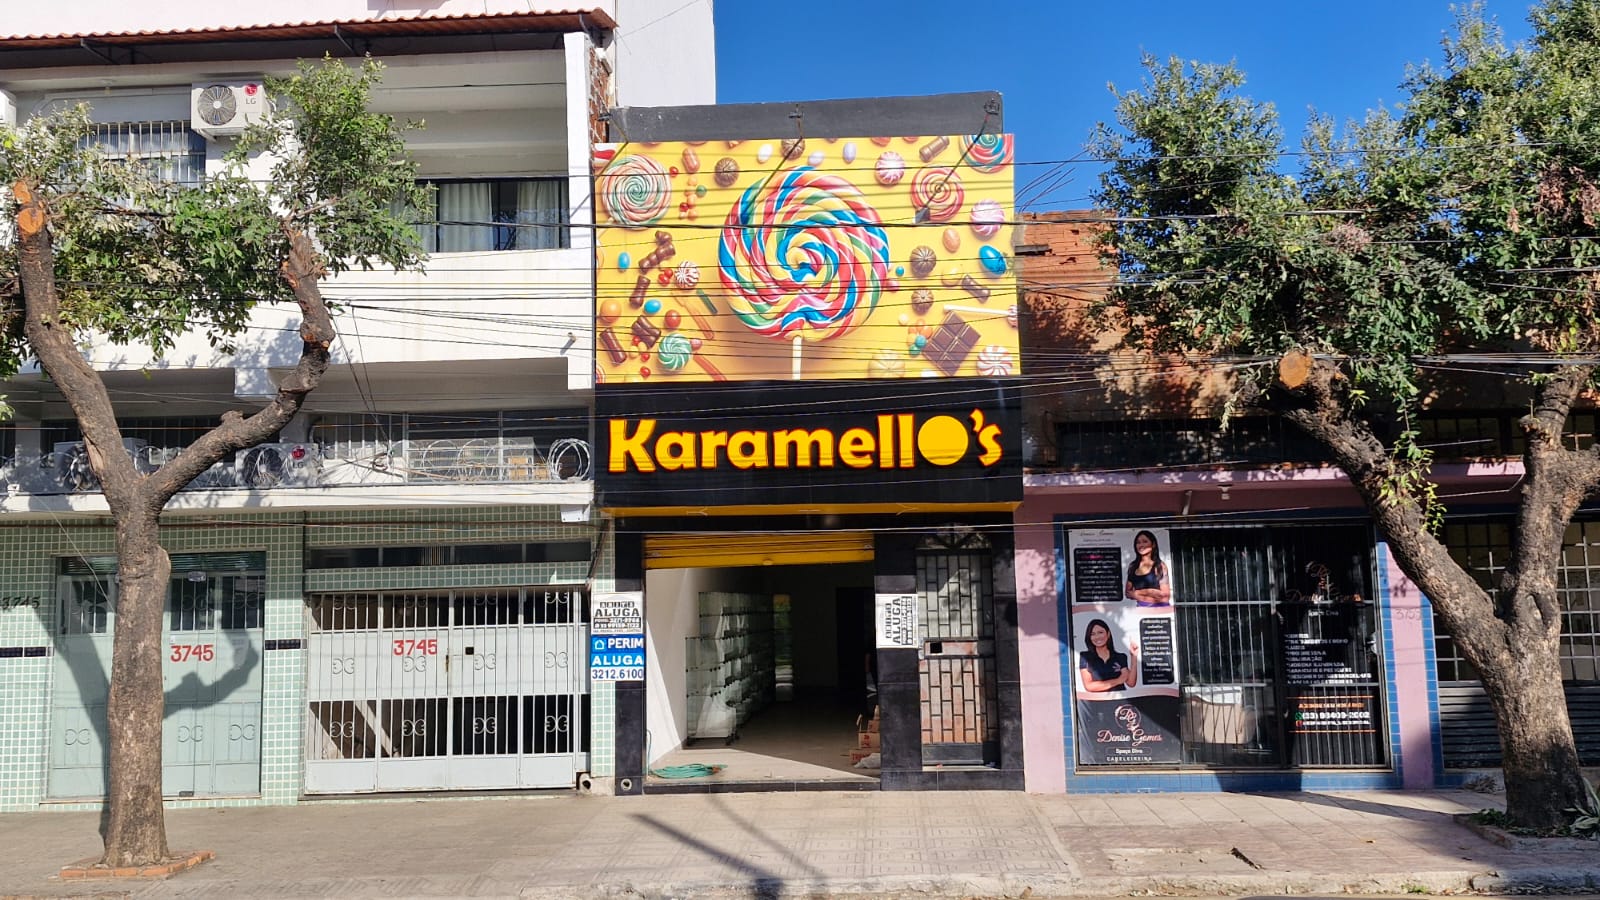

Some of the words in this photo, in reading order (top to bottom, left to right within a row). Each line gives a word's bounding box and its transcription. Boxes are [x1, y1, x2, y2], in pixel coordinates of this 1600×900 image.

[245, 97, 257, 105] LG
[594, 607, 640, 618] ALUGA
[892, 598, 901, 644] ALUGA
[393, 639, 438, 656] 3745
[607, 637, 644, 650] PERIM
[170, 644, 214, 662] 3745
[591, 655, 644, 666] ALUGA
[591, 668, 644, 680] 3212.6100
[1097, 730, 1131, 742] Denise
[1131, 728, 1163, 747] Gomes
